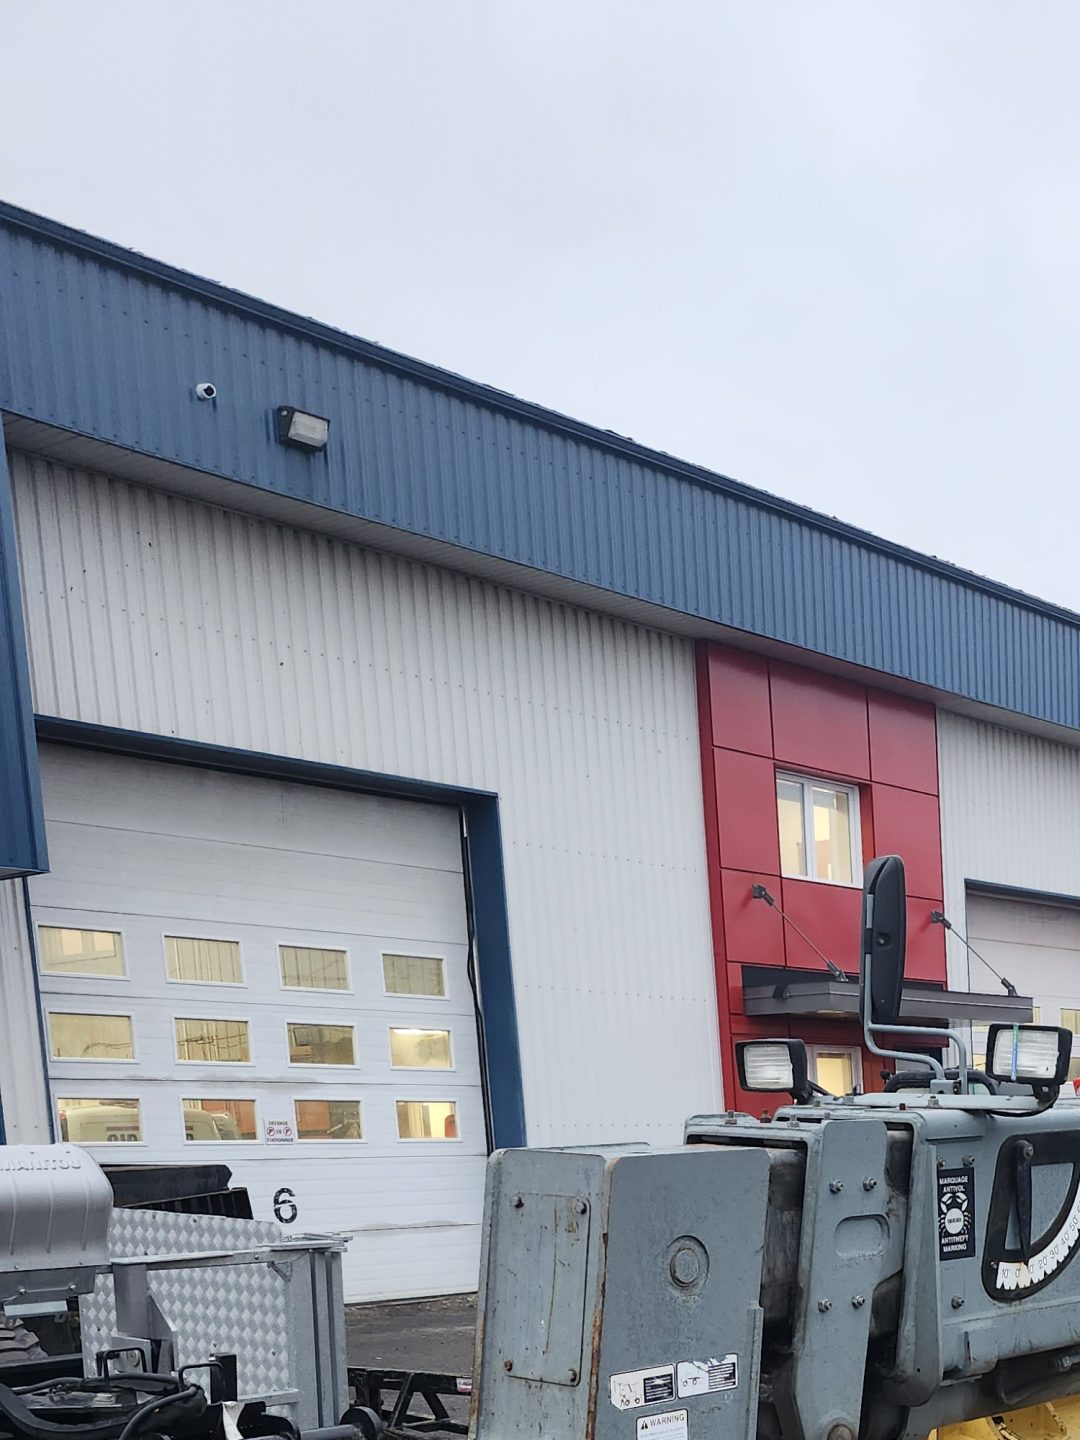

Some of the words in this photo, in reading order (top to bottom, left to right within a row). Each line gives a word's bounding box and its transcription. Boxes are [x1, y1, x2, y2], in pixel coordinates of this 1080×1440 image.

[939, 1175, 969, 1185] MARQUAGE
[942, 1184, 966, 1194] ANTIVOL
[273, 1187, 298, 1224] 6
[941, 1234, 969, 1245] ANTITHEFT
[943, 1243, 967, 1253] MARKING
[649, 1413, 685, 1427] WARNING
